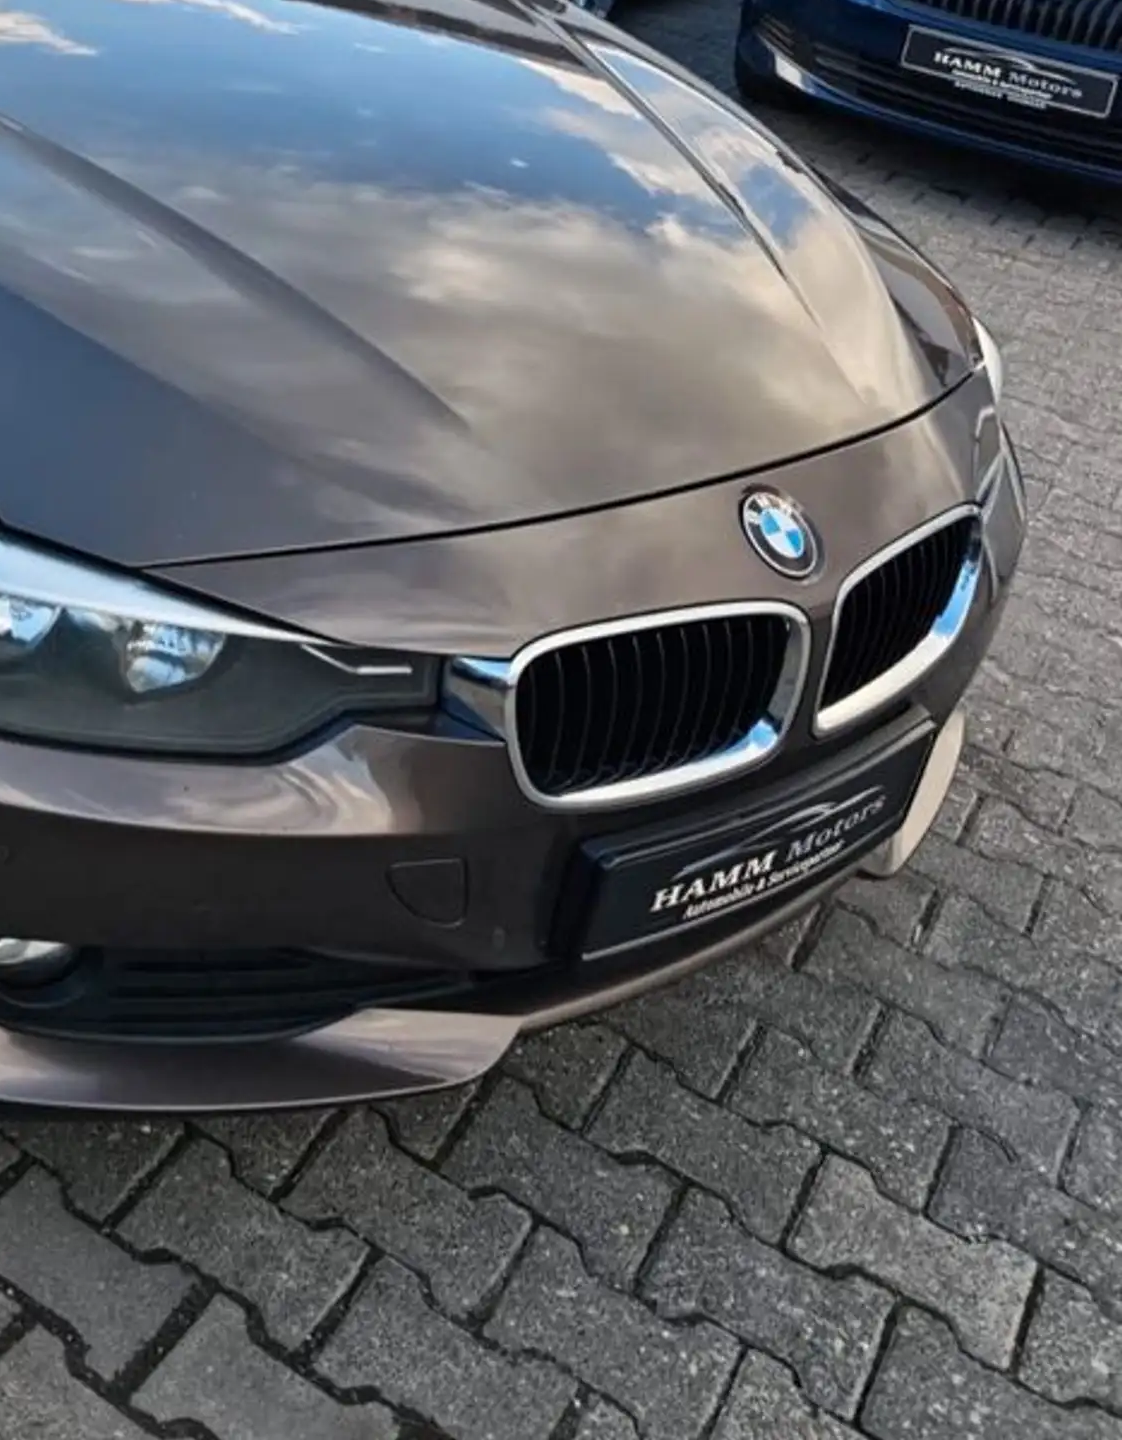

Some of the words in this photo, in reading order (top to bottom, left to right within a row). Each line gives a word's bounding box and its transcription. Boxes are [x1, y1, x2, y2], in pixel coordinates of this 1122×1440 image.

[933, 51, 1002, 79] HAMM
[1008, 70, 1083, 99] Motors
[650, 849, 778, 913] HAMM
[785, 794, 887, 862] Motors
